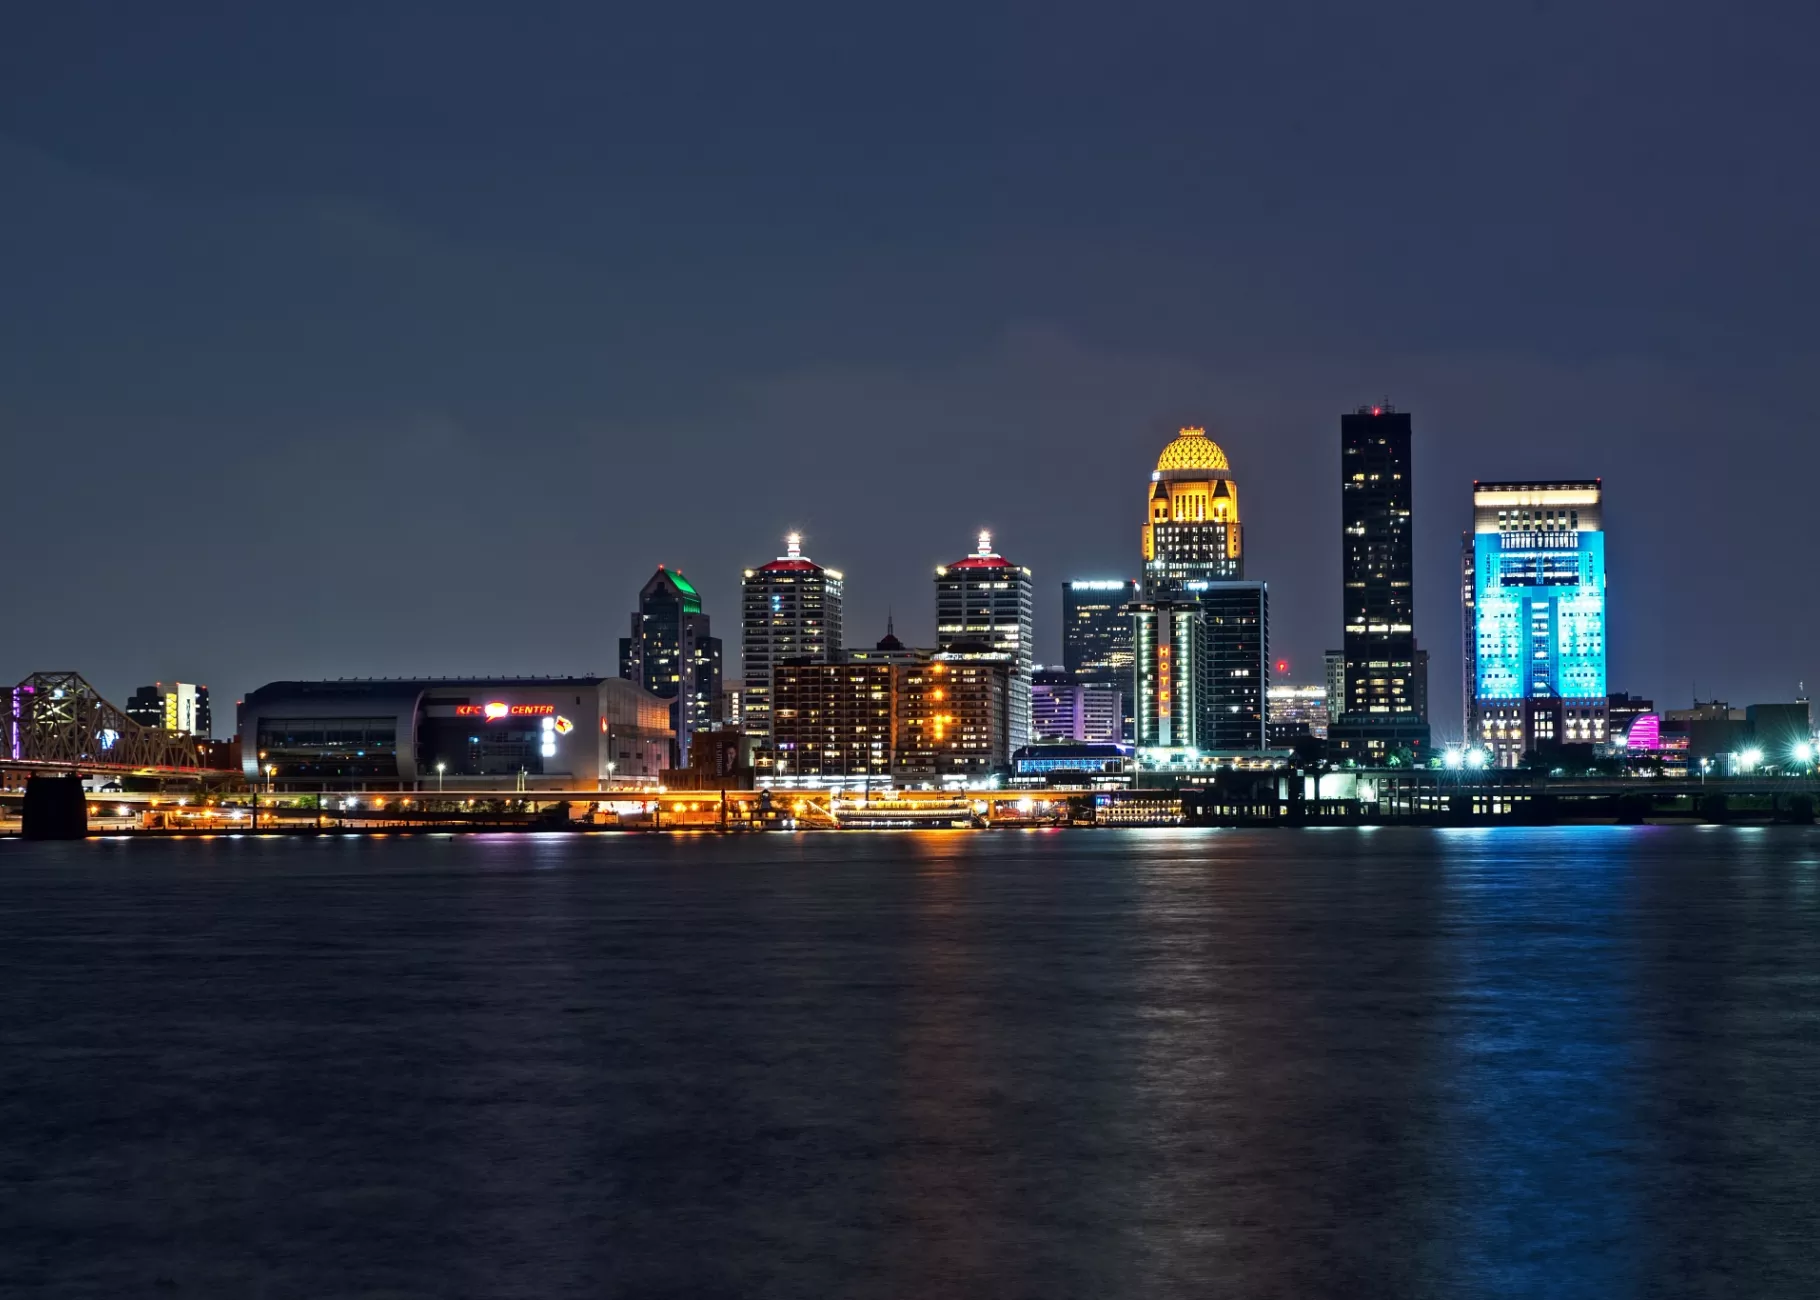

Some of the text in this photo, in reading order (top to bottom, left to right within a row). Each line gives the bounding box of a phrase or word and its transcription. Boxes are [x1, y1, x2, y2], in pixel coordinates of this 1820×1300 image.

[1159, 646, 1169, 716] HOTEL
[456, 705, 482, 715] KFC
[511, 705, 554, 715] CENTER
